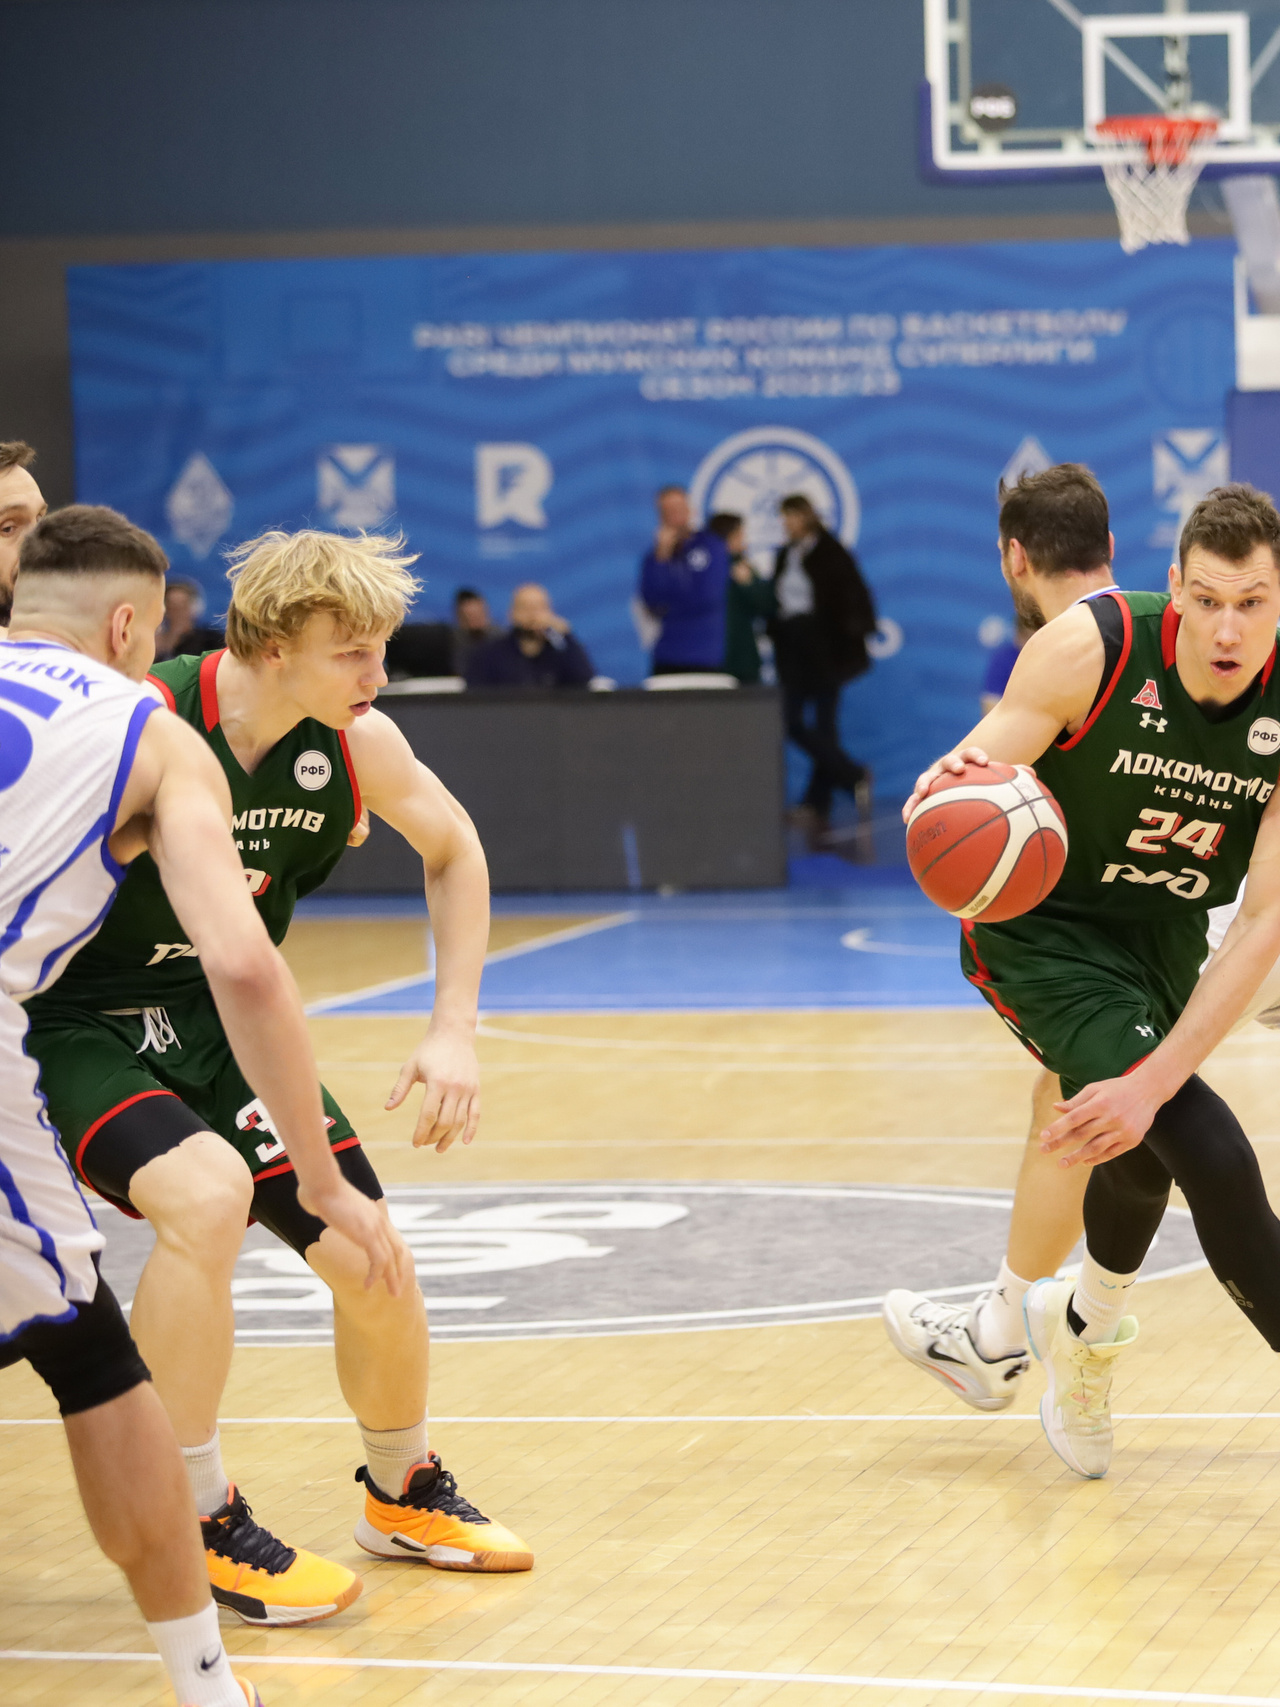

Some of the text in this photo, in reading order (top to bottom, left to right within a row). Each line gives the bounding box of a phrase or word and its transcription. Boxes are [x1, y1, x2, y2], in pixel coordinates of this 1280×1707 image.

[1252, 730, 1278, 743] РФБ
[301, 765, 325, 776] РФБ
[1109, 748, 1276, 803] ЛОКОМОТИВ
[1154, 784, 1232, 810] КУБАНЬ
[230, 807, 326, 833] МОТИВ
[1125, 807, 1227, 860] 24
